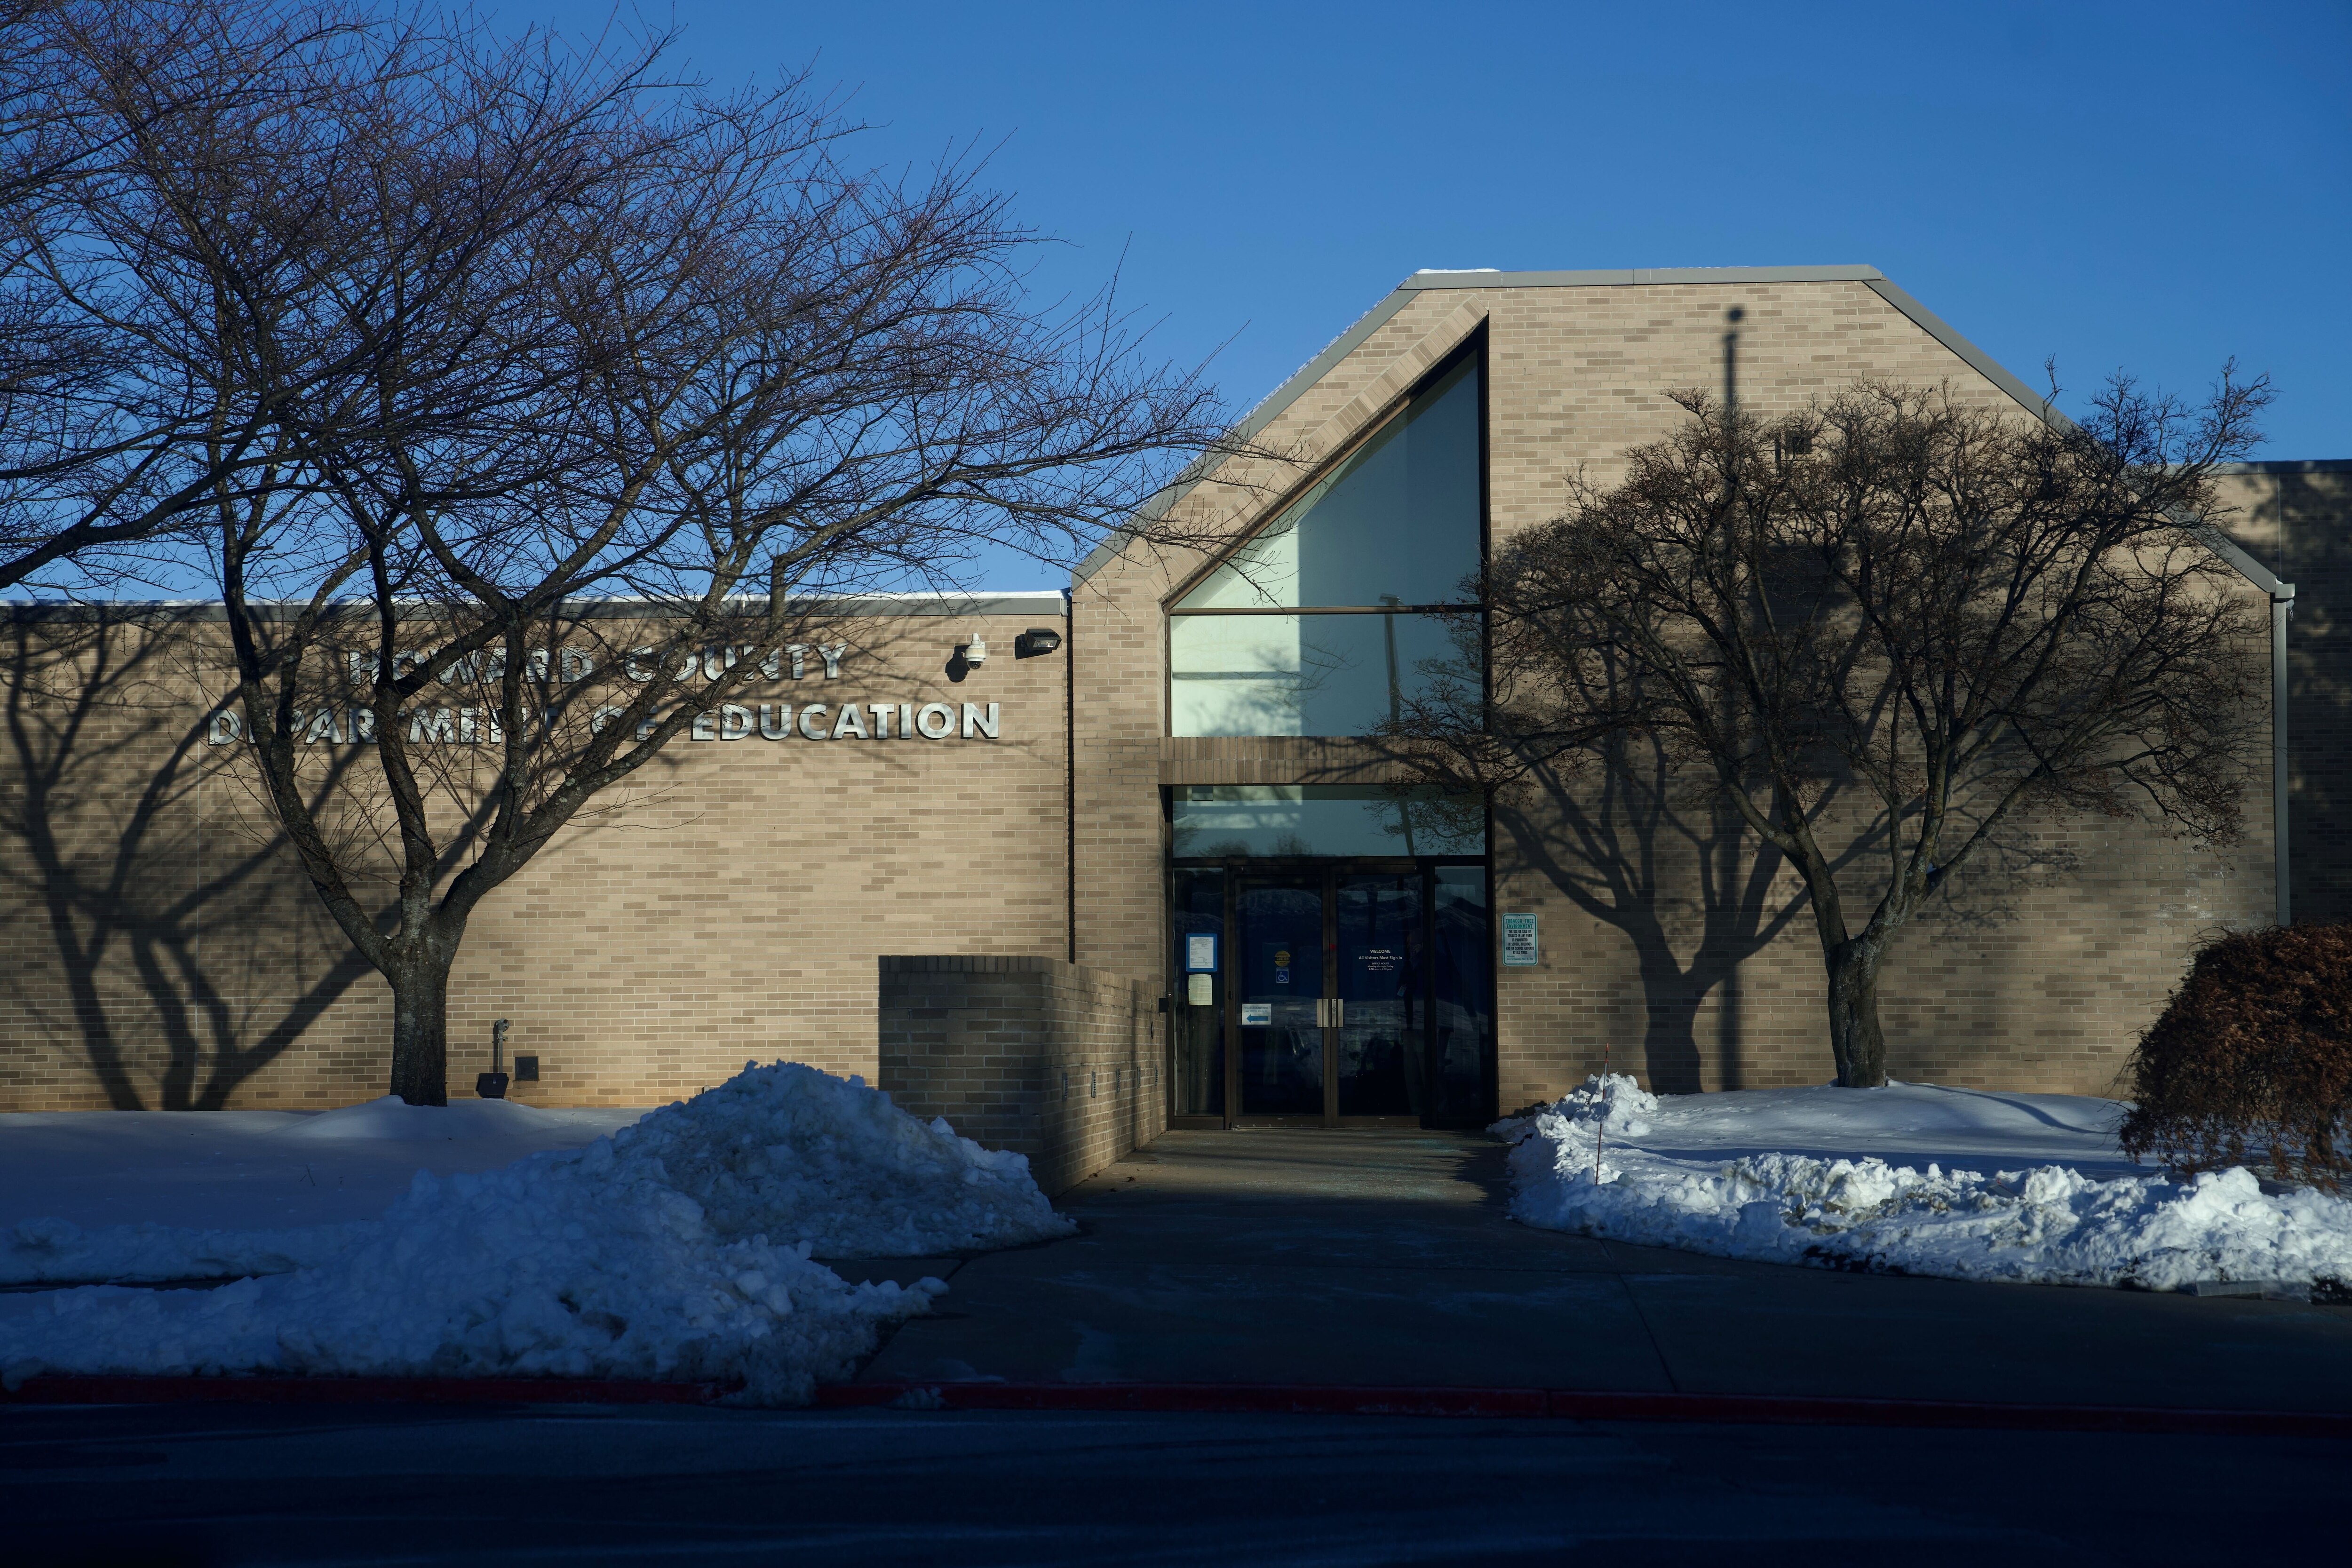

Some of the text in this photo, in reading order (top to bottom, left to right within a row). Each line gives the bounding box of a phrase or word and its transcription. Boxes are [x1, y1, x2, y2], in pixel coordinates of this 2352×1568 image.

[349, 643, 847, 685] HOWARD COUNTY
[208, 702, 999, 746] DARMENT OF EDUCATION
